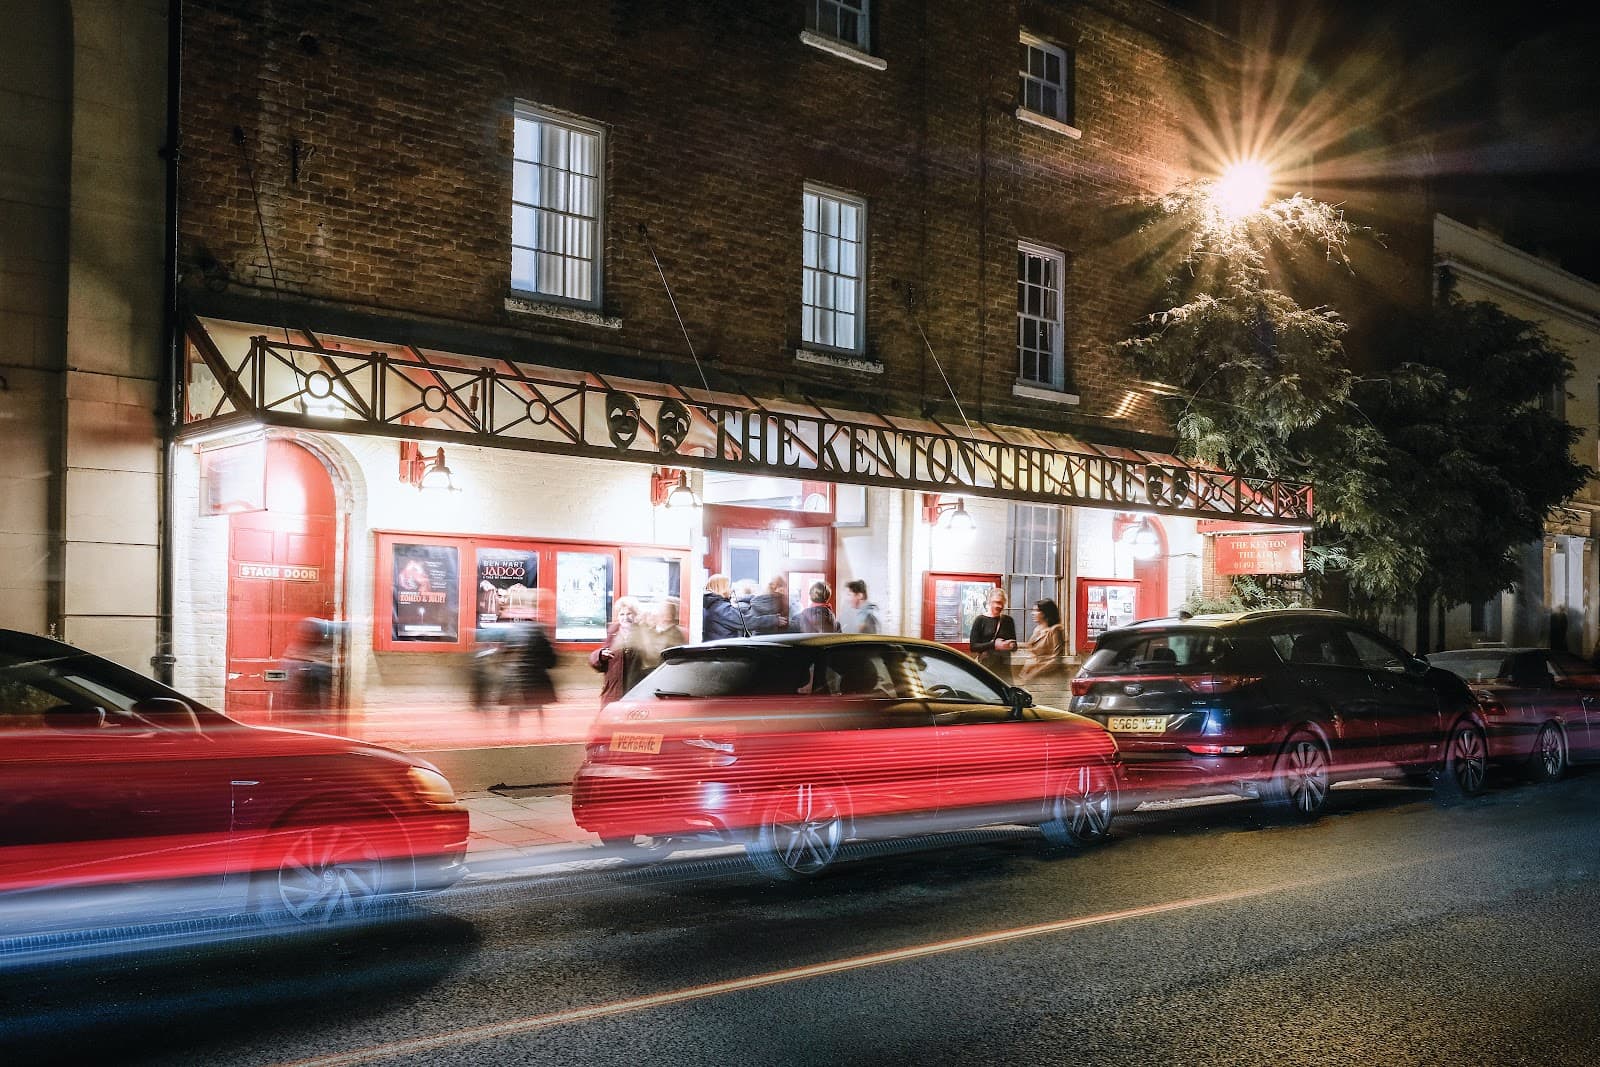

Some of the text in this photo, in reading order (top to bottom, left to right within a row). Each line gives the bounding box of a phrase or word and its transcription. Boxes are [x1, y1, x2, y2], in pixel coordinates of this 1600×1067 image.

[706, 405, 1138, 502] THE KENTON THEATRE
[1231, 540, 1287, 550] THE KENTON
[241, 565, 317, 579] STAGE DOOR
[481, 566, 525, 577] JADOO
